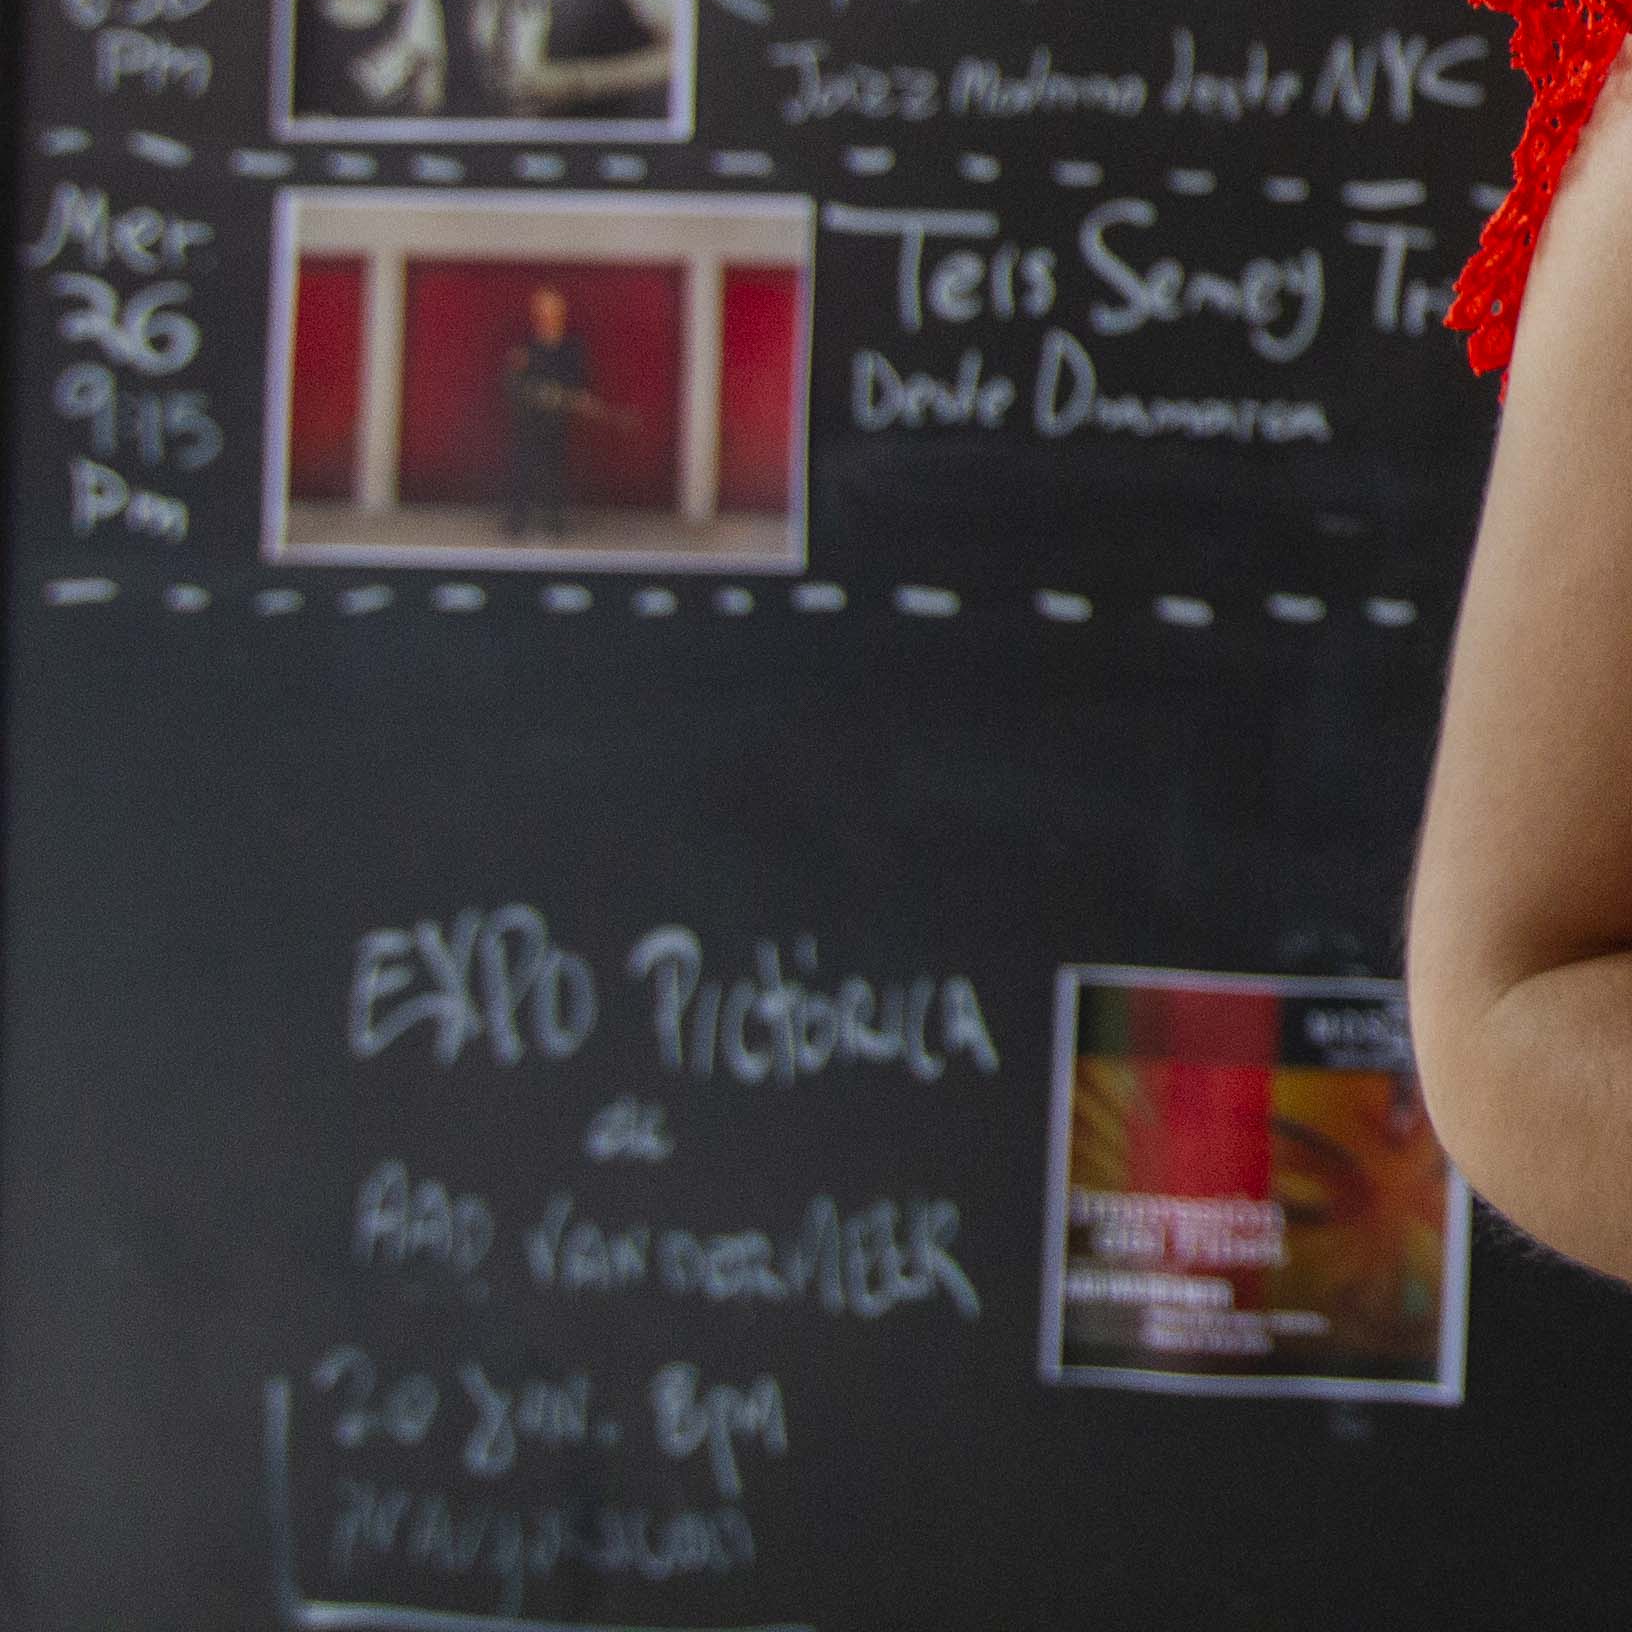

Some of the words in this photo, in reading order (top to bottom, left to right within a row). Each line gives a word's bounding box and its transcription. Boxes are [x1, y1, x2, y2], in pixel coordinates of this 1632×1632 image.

[767, 37, 941, 126] Jazz
[1313, 30, 1490, 125] NYC
[51, 271, 199, 376] 26
[1344, 219, 1455, 338] Tr
[351, 903, 596, 1066] EXPO
